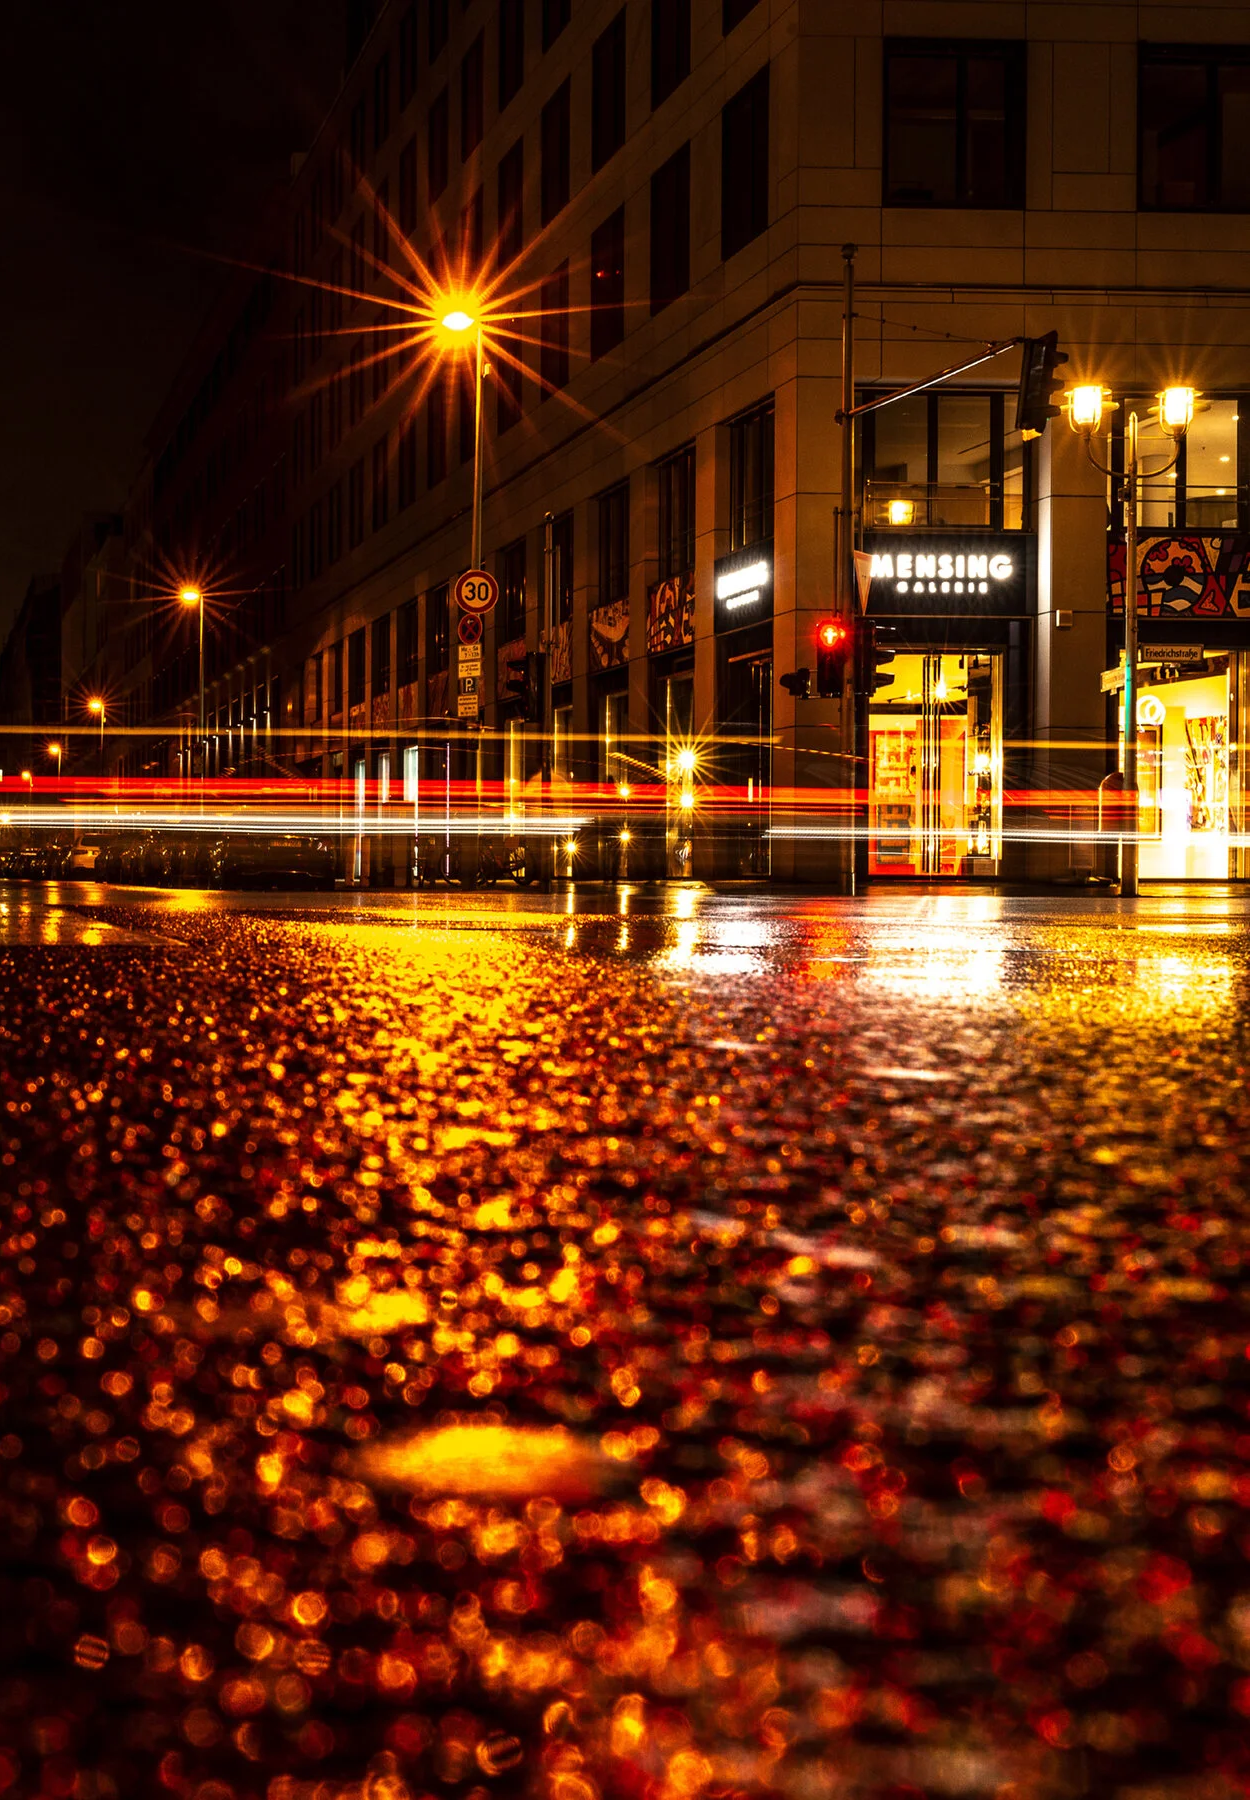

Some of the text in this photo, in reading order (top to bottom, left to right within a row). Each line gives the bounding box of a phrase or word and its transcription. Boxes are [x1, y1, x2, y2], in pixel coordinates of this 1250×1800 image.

[870, 553, 1013, 580] MENSING
[464, 581, 489, 602] 30
[1145, 648, 1198, 660] Friedrichstraße
